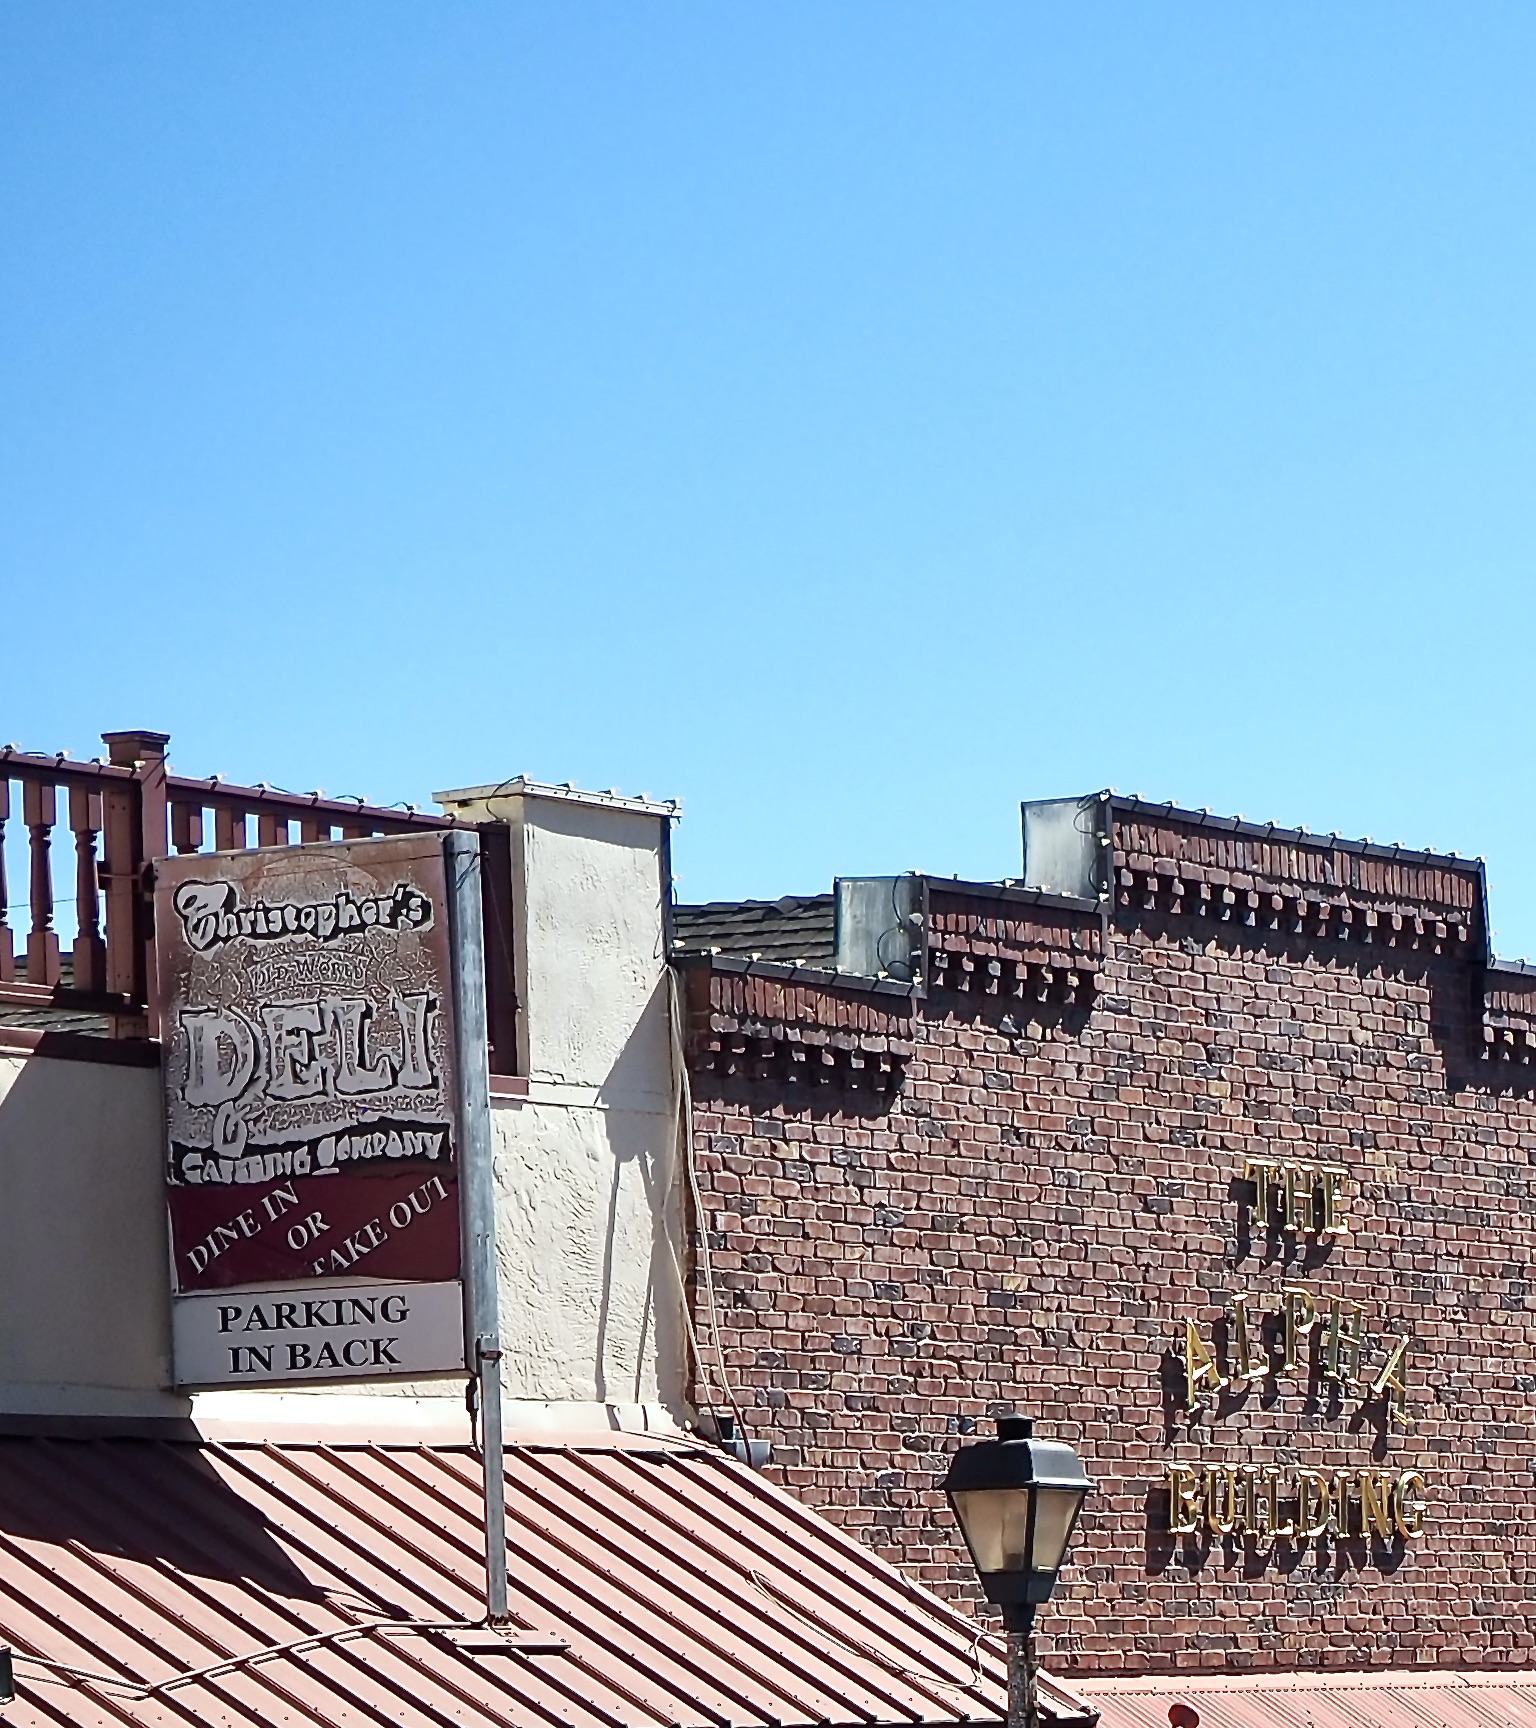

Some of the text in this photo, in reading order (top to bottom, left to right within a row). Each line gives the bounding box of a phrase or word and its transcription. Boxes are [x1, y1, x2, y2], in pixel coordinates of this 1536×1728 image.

[176, 880, 432, 950] Christopher's
[178, 992, 434, 1105] DELI
[187, 1180, 301, 1275] DINE IN
[286, 1210, 331, 1252] OR
[388, 1175, 450, 1229] OUT
[218, 1295, 411, 1334] PARKING
[228, 1336, 402, 1375] IN BACK
[1167, 1462, 1427, 1539] BUILDING
